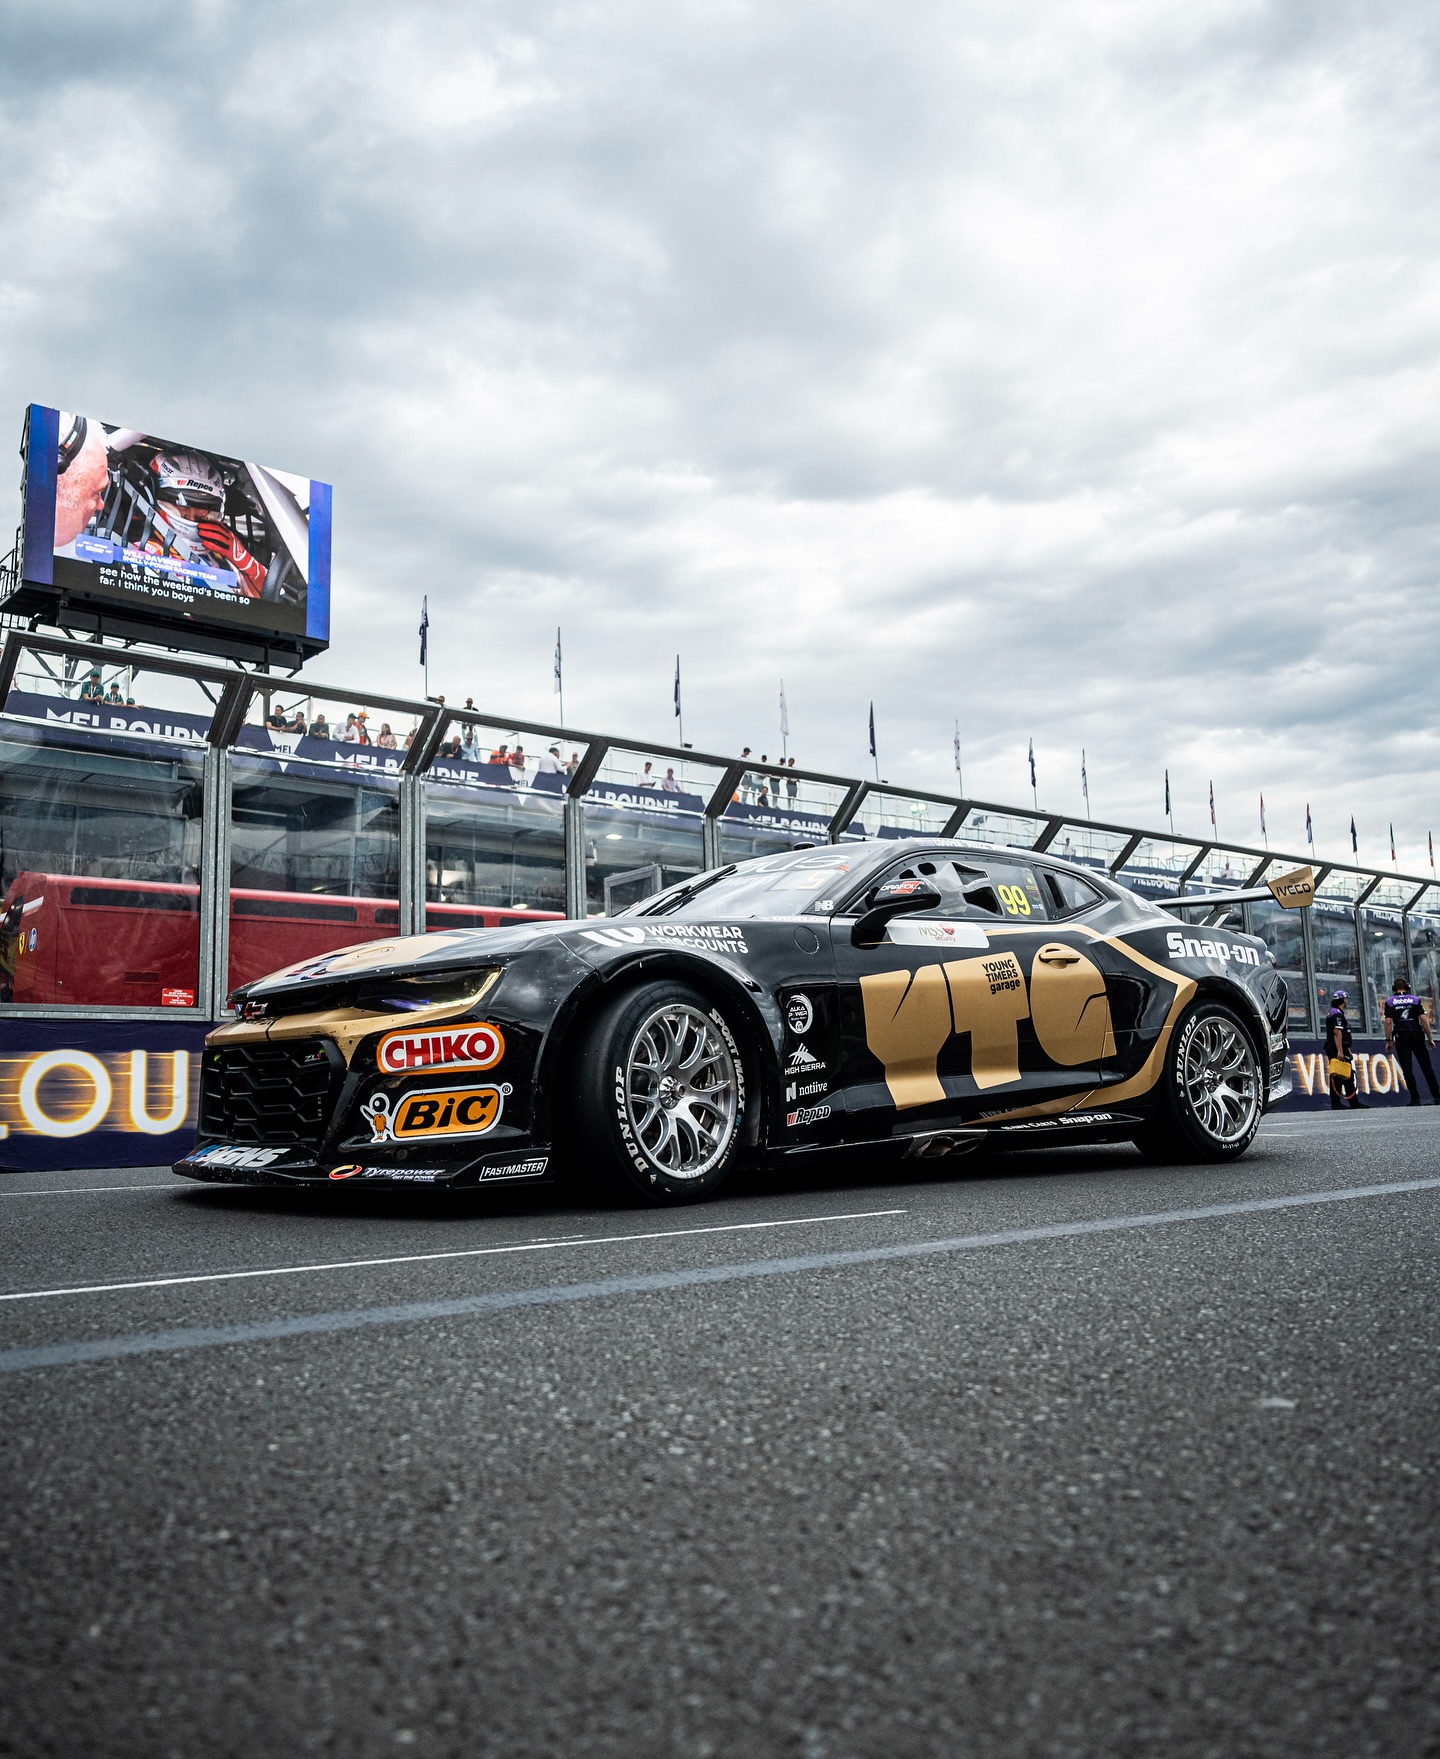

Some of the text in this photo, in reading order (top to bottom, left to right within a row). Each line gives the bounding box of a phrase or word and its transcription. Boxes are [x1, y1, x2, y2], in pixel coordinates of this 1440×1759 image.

[186, 479, 213, 492] Repco
[123, 549, 144, 559] WILL
[122, 556, 217, 581] SHELL V-POWER RACING TEAM
[100, 567, 250, 605] see how the weekend's been so
[100, 575, 115, 587] far.
[124, 580, 149, 593] think
[151, 585, 170, 597] you
[172, 589, 194, 603] boys
[46, 707, 208, 742] MELBOURN
[1276, 883, 1311, 897] IVECO
[997, 884, 1032, 916] 99
[645, 925, 744, 939] WORKWEAR
[918, 925, 944, 937] MSS
[655, 937, 749, 954] DISCOUNTS
[1166, 932, 1261, 967] Snap-on
[982, 959, 1015, 973] YOUNG
[985, 968, 1018, 983] TIMERS
[990, 979, 1021, 995] garage
[788, 1010, 808, 1018] PWER
[385, 1032, 495, 1069] CHIKO
[1176, 1015, 1197, 1086] DUNLOP
[708, 1008, 746, 1113] SPORT MAXX
[784, 1061, 827, 1076] HIGH SIERRA
[0, 1050, 190, 1140] OU
[798, 1081, 828, 1096] natiive
[615, 1066, 650, 1173] DUNLOP
[795, 1105, 831, 1125] Repco
[1058, 1113, 1113, 1126] Snap-on
[363, 1166, 446, 1177] Tyrepower
[483, 1161, 544, 1178] FASTMASTER
